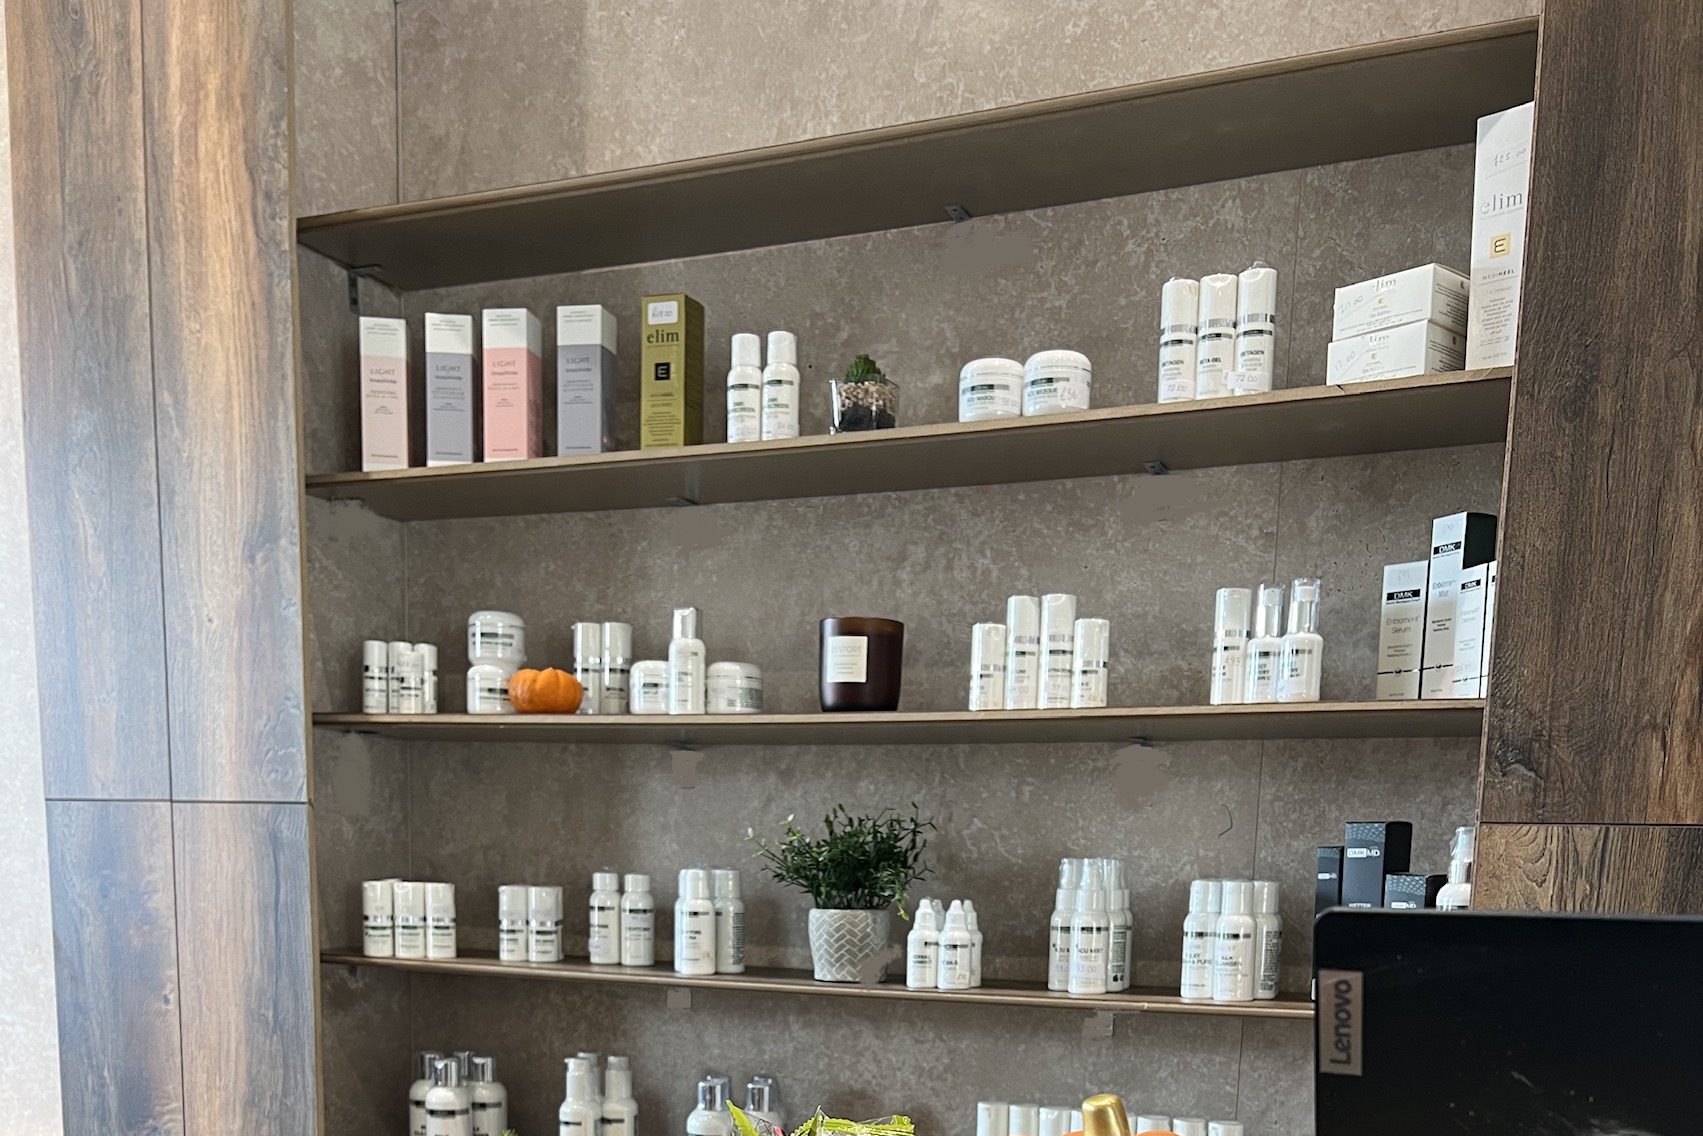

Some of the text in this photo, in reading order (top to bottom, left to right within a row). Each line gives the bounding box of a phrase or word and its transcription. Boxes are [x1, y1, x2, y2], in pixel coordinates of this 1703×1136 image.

[1481, 192, 1523, 215] elim
[646, 329, 680, 344] elim
[1439, 543, 1456, 554] DMK
[1393, 590, 1414, 600] DMK
[1329, 979, 1352, 1065] Lenovo
